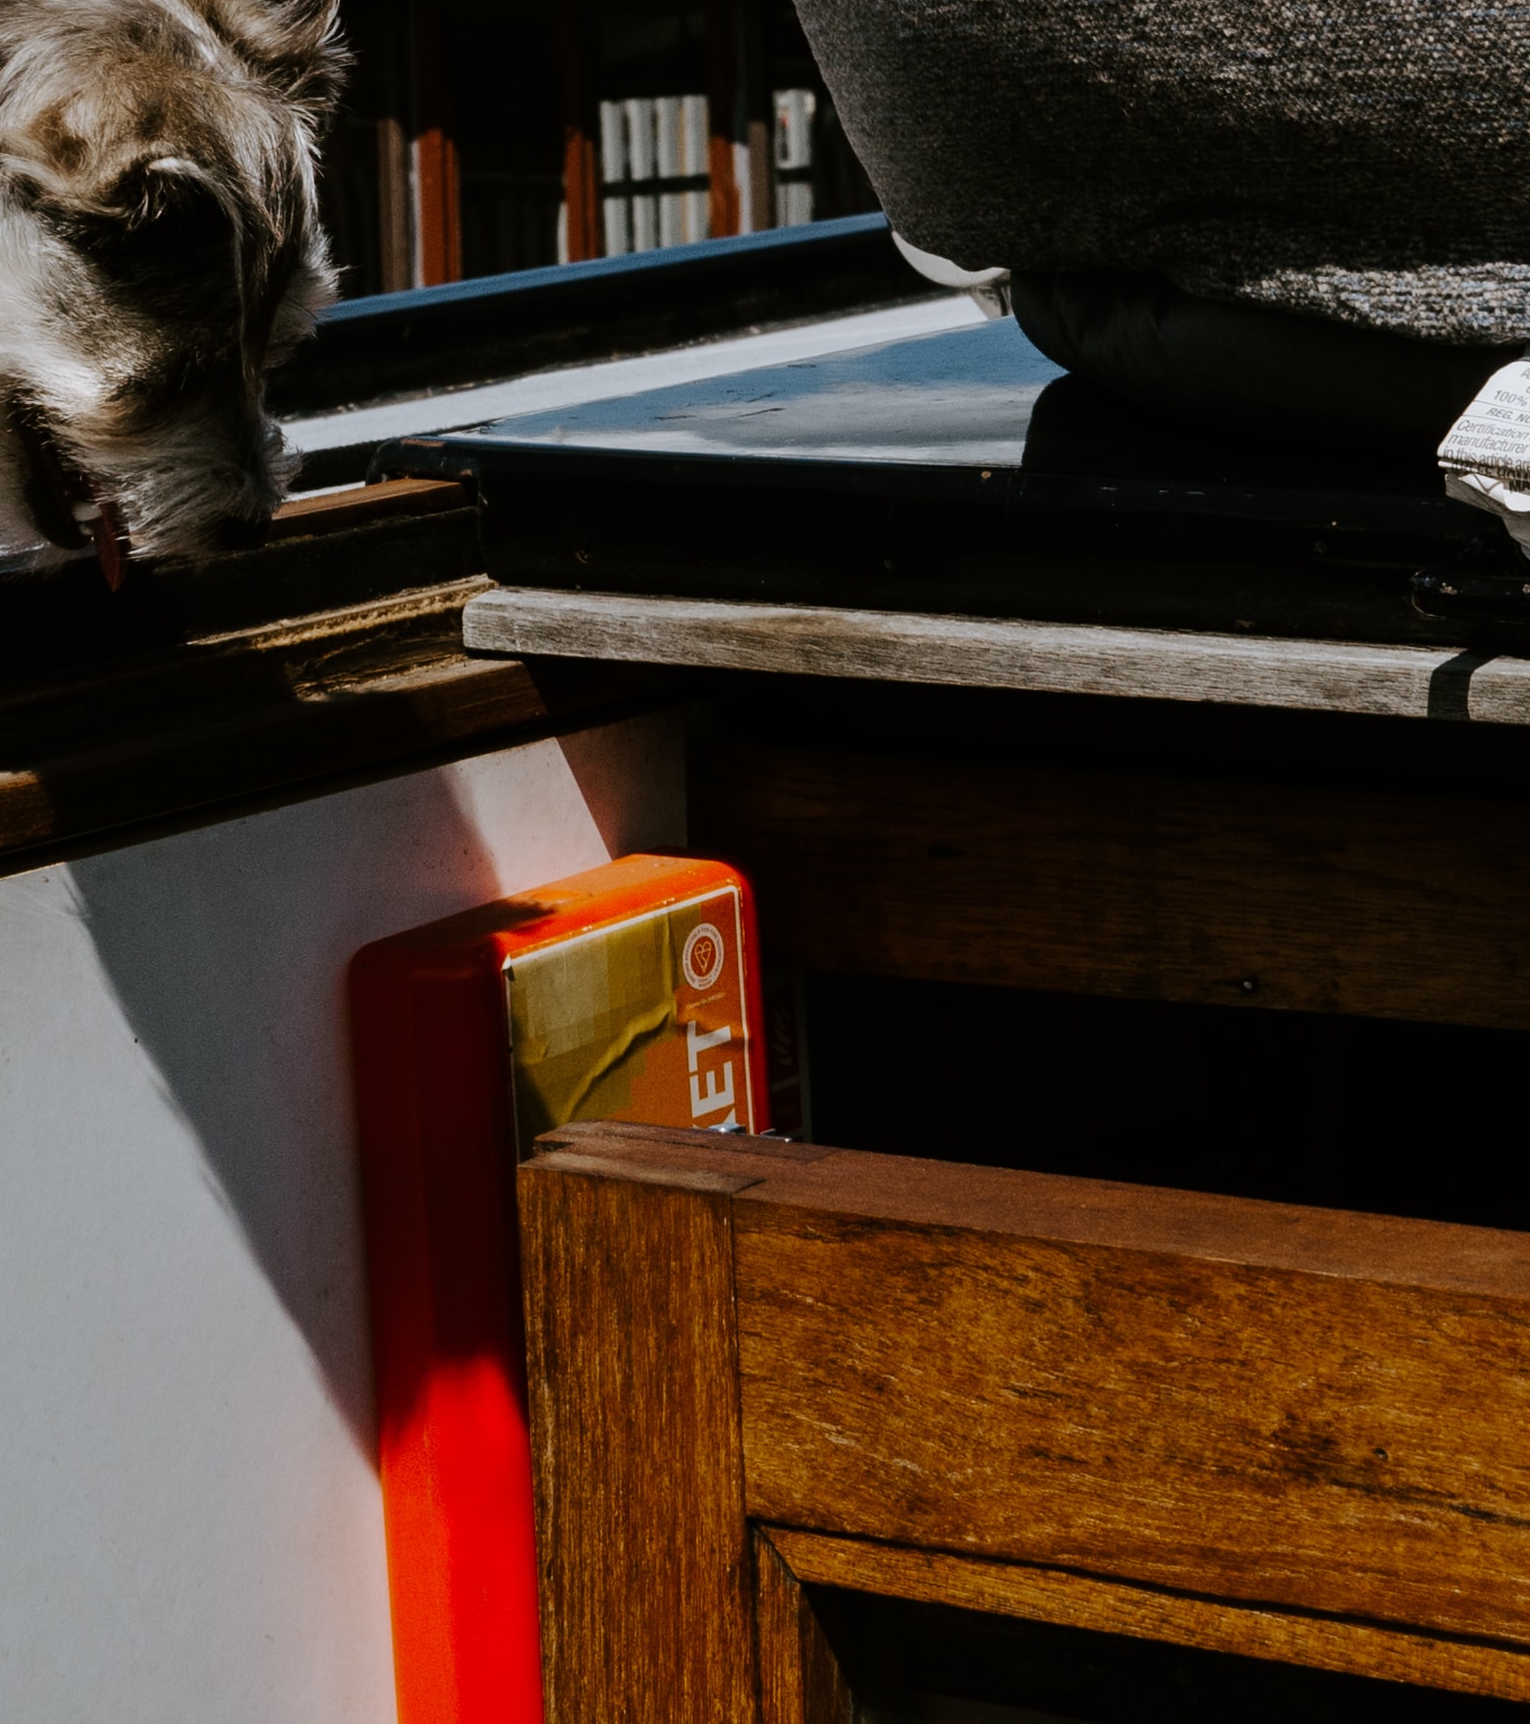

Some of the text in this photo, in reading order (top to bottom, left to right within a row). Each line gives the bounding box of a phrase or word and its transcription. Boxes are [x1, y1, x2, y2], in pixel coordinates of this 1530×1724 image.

[1492, 389, 1528, 408] 100%
[1485, 406, 1514, 421] REG.
[1455, 418, 1530, 441] Certification
[1446, 433, 1529, 454] manufacturer
[1442, 446, 1455, 460] in
[1455, 448, 1477, 464] this
[1477, 451, 1517, 469] article
